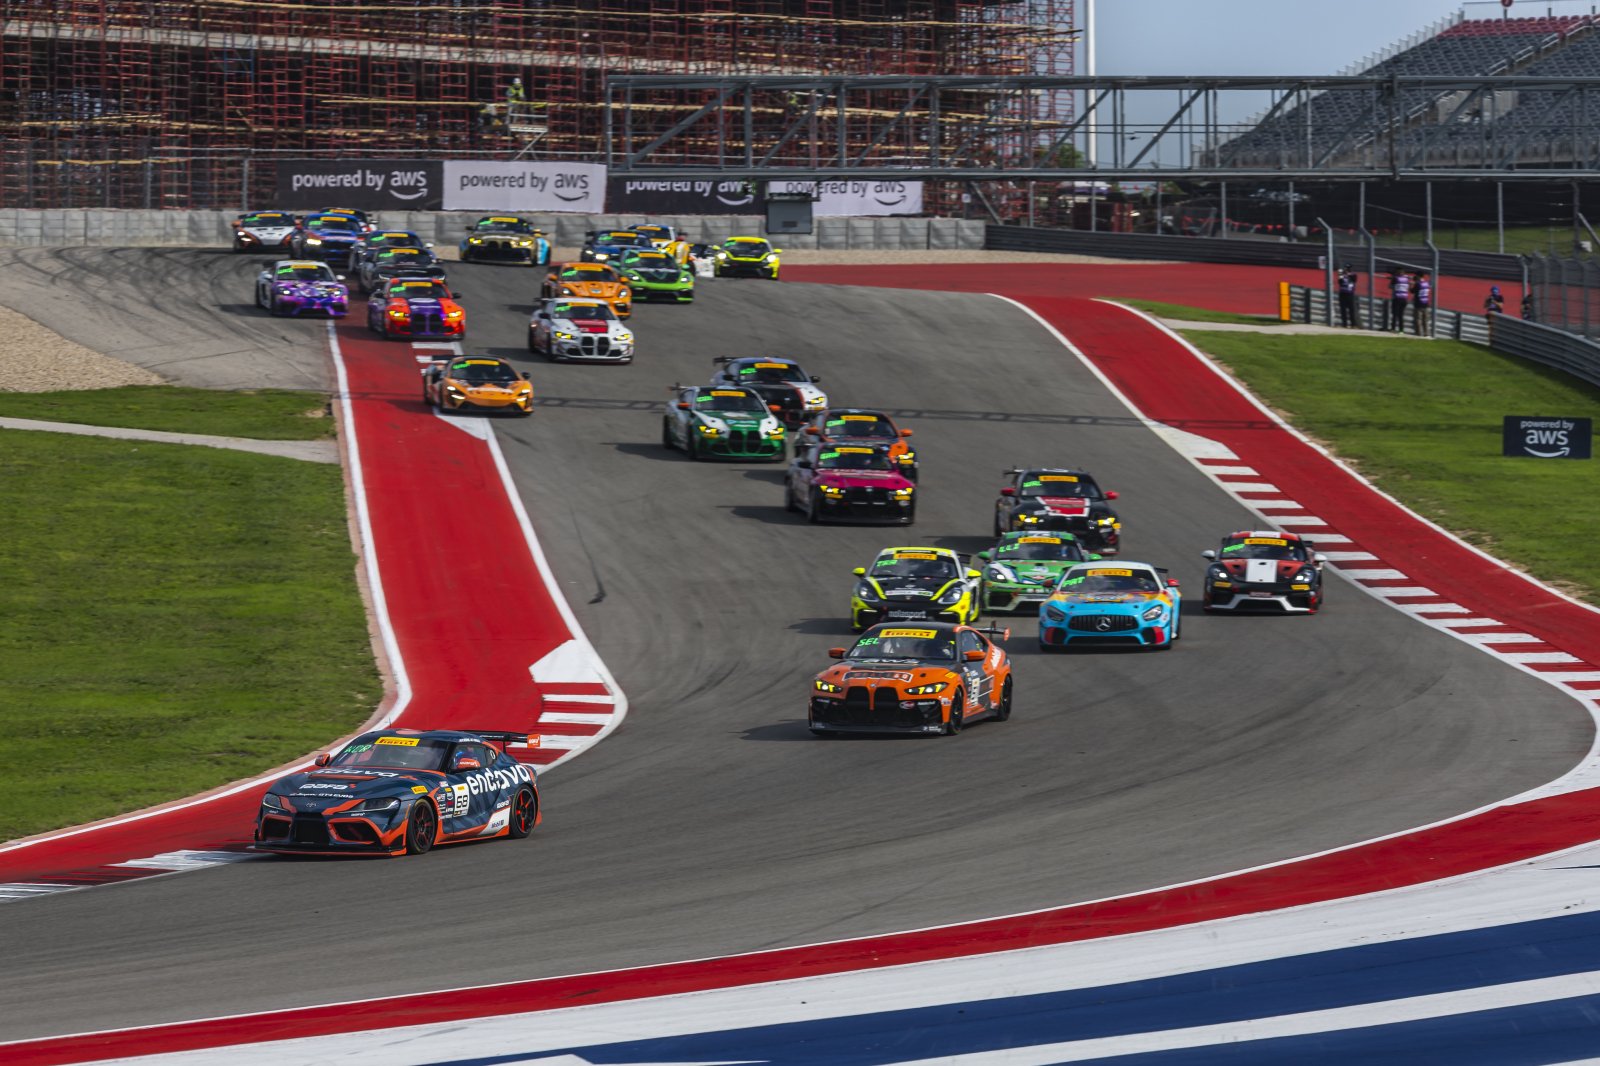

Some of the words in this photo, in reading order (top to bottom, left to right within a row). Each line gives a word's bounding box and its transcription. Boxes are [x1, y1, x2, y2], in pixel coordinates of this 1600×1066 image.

[292, 169, 362, 191] powered
[365, 170, 386, 191] by
[390, 170, 427, 187] aws
[459, 171, 526, 191] powered
[530, 172, 549, 192] by
[554, 172, 589, 189] aws
[873, 181, 906, 194] aws
[1520, 420, 1561, 429] powered
[1562, 420, 1575, 431] by
[1525, 429, 1569, 446] aws
[857, 637, 880, 647] SEL
[466, 764, 531, 795] endava
